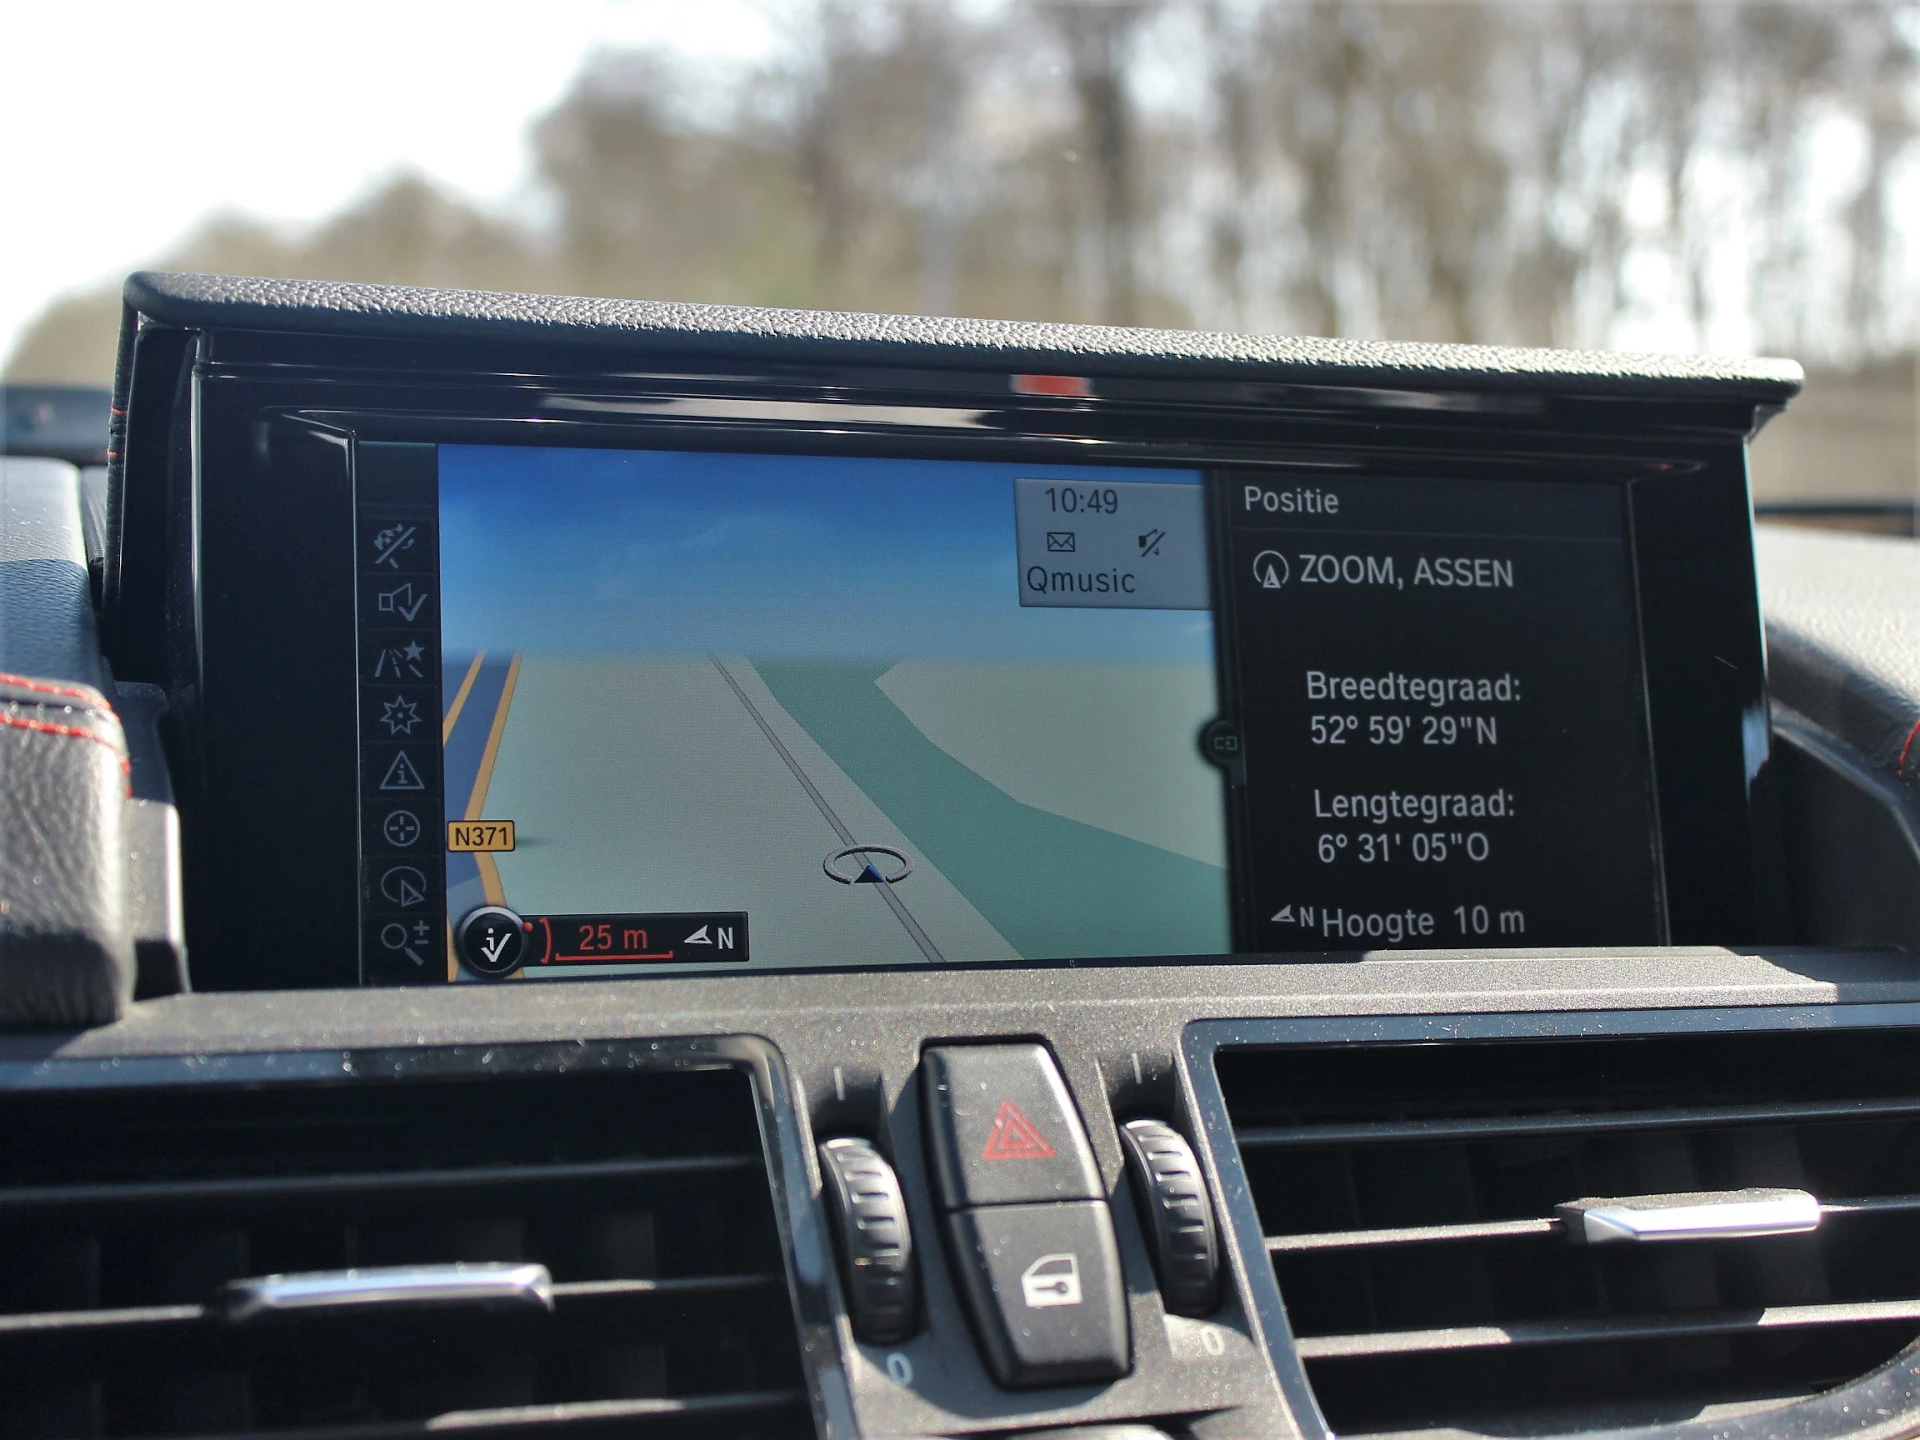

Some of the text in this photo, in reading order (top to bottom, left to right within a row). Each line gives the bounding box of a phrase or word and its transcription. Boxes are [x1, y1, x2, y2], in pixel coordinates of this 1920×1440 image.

[1045, 487, 1119, 515] 10:49
[1243, 486, 1340, 514] Positie
[1027, 566, 1136, 595] Qmusic
[1300, 554, 1514, 590] ZOOM, ASSEN
[1306, 671, 1521, 706] Breedtegraad:
[1369, 716, 1412, 745] 59'
[1314, 789, 1515, 823] Lengtegraad:
[454, 825, 509, 847] N371
[1358, 833, 1402, 862] 31'
[1300, 906, 1314, 928] N
[1321, 906, 1526, 942] Hoogte 10 m
[578, 925, 648, 951] 25 m
[716, 927, 735, 950] N
